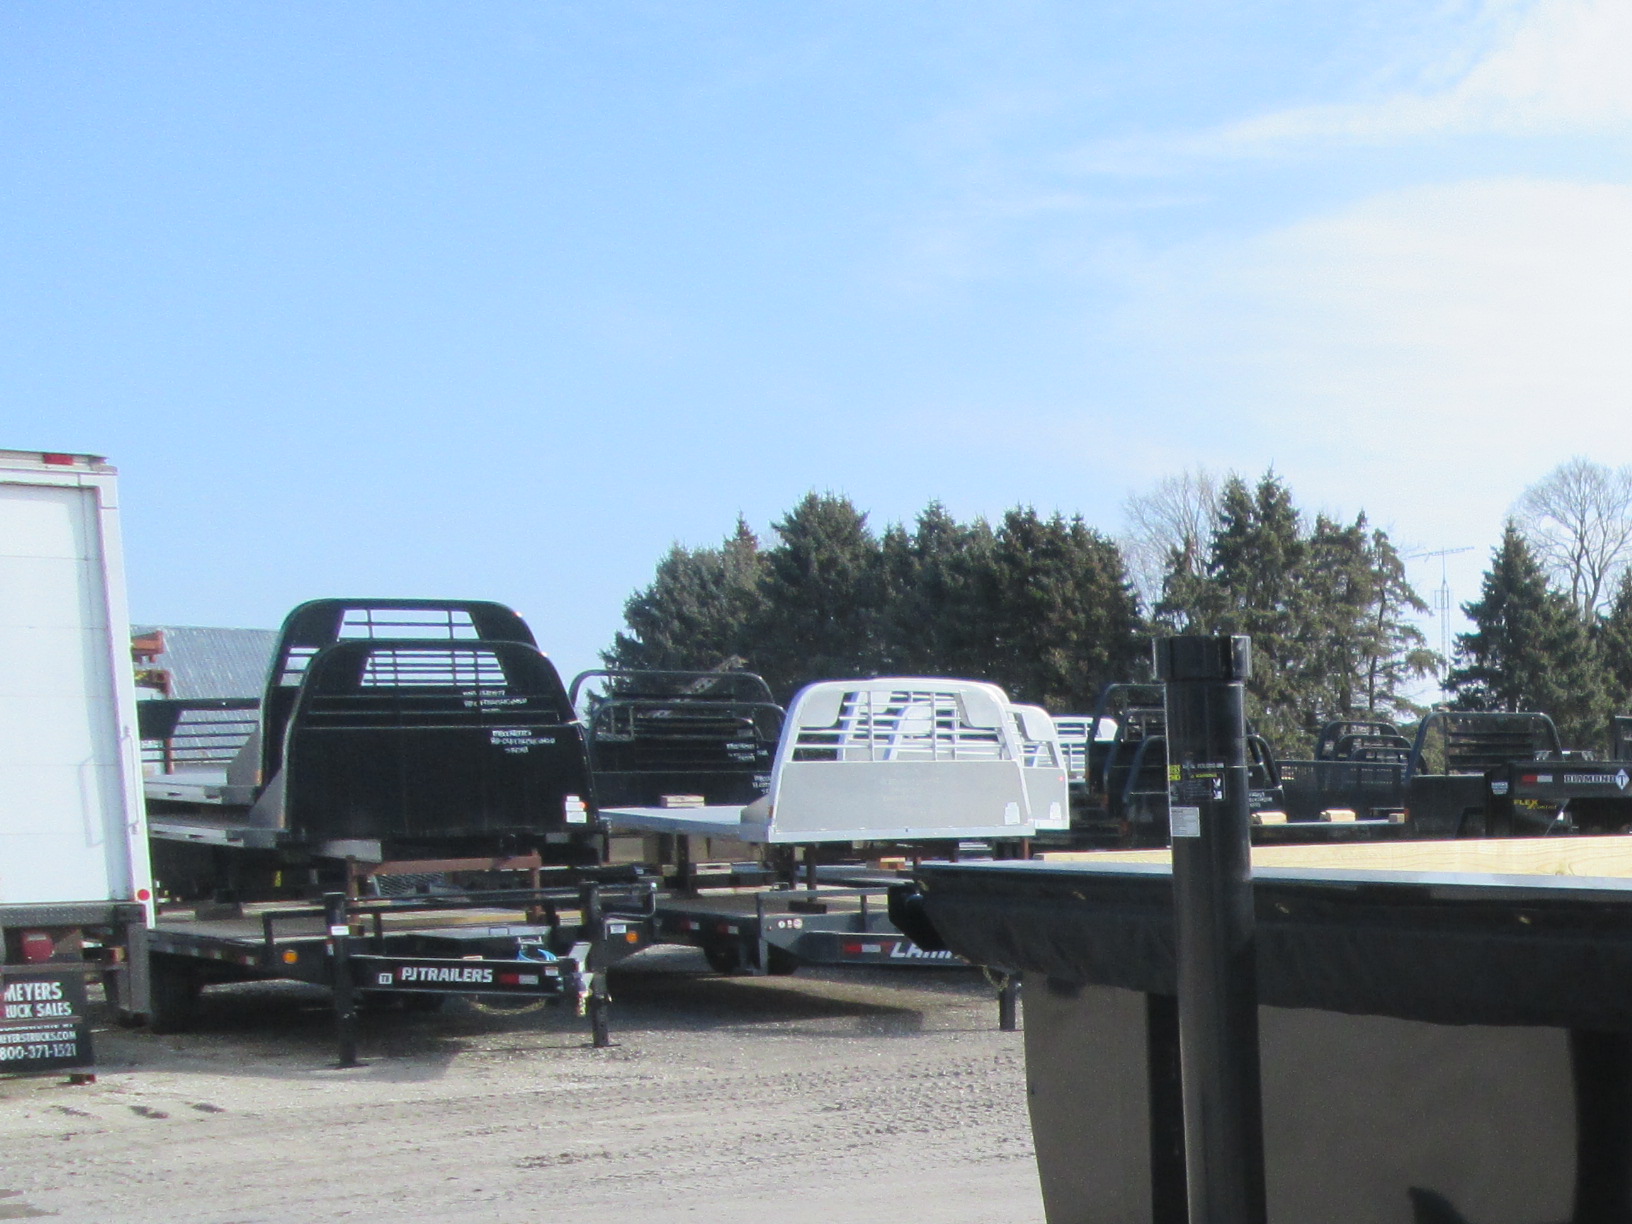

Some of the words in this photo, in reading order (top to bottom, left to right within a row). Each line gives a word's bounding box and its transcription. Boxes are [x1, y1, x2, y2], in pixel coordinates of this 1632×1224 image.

[1563, 774, 1616, 783] DIAMOND
[1513, 798, 1540, 810] FLEX
[419, 967, 493, 983] TRAILERS
[4, 982, 62, 1001] MEYERS
[36, 1001, 72, 1017] SALES
